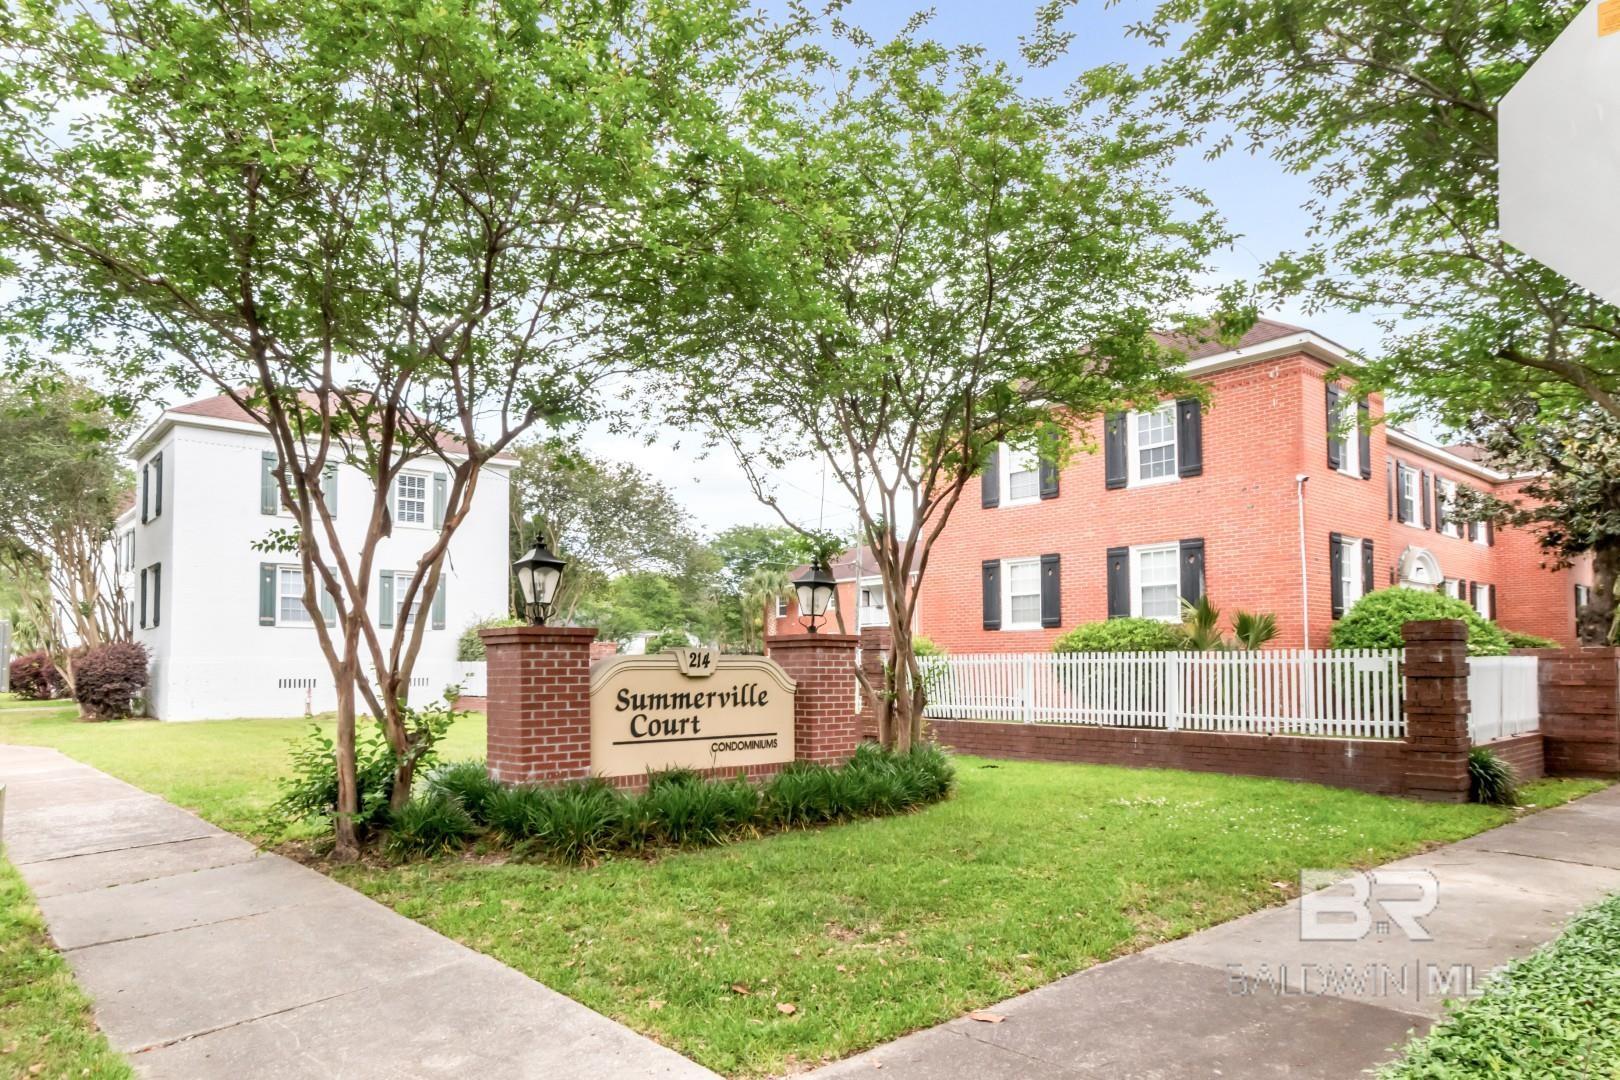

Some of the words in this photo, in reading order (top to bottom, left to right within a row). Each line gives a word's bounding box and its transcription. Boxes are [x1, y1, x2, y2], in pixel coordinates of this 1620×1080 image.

[689, 651, 711, 669] 214
[615, 683, 769, 712] Summerville
[630, 713, 701, 738] Court
[711, 738, 778, 753] CONDOMINIUMS
